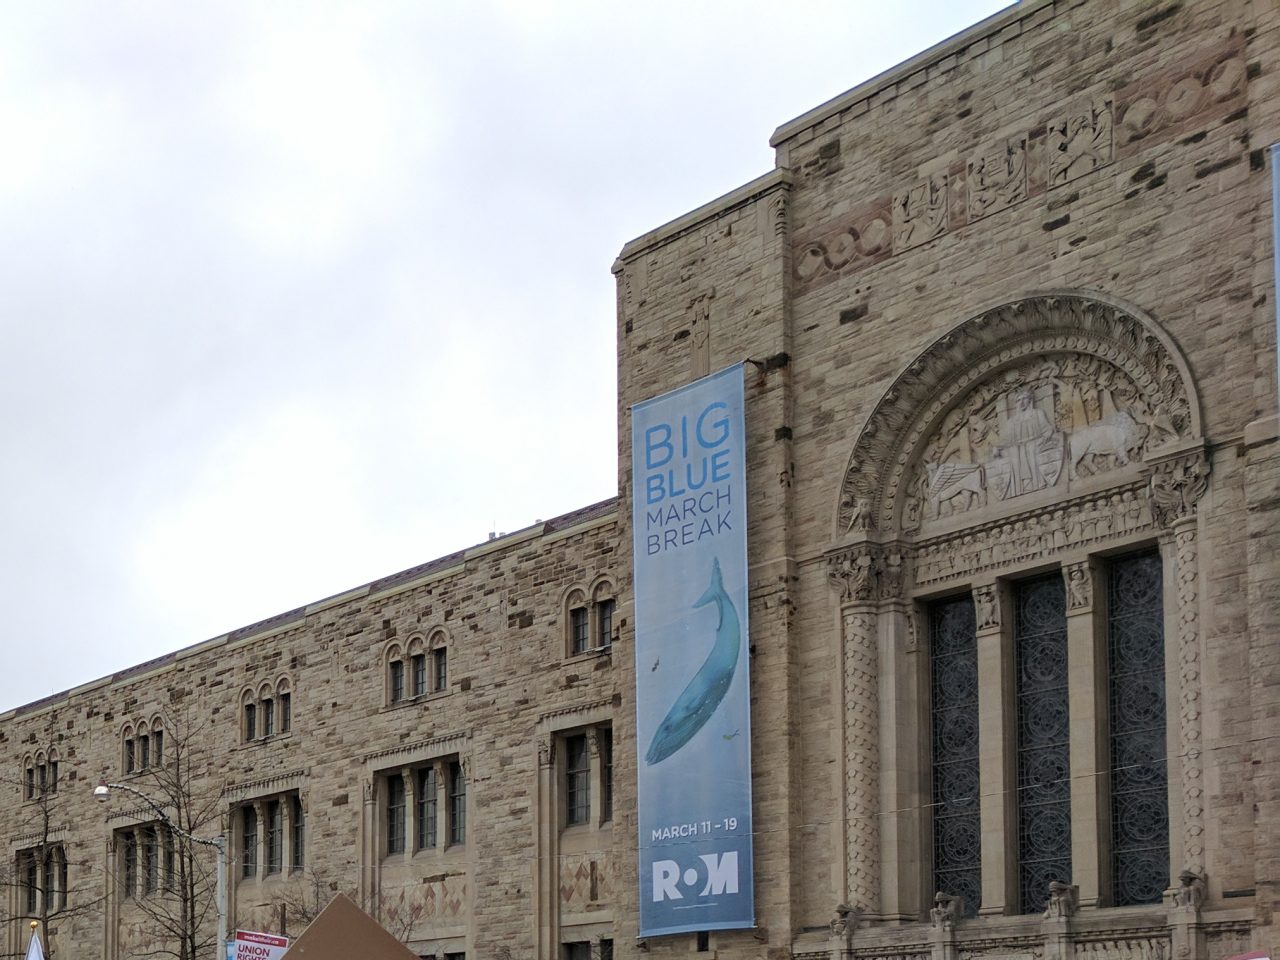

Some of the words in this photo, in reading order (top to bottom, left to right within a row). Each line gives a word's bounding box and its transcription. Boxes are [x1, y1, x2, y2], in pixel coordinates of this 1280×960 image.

[645, 402, 730, 470] BIG
[646, 449, 731, 505] BLUE
[646, 484, 731, 531] MARCH
[647, 510, 732, 556] BREAK
[651, 823, 698, 841] MARCH
[701, 820, 711, 834] 11
[723, 817, 737, 831] 19
[238, 943, 270, 957] UNION
